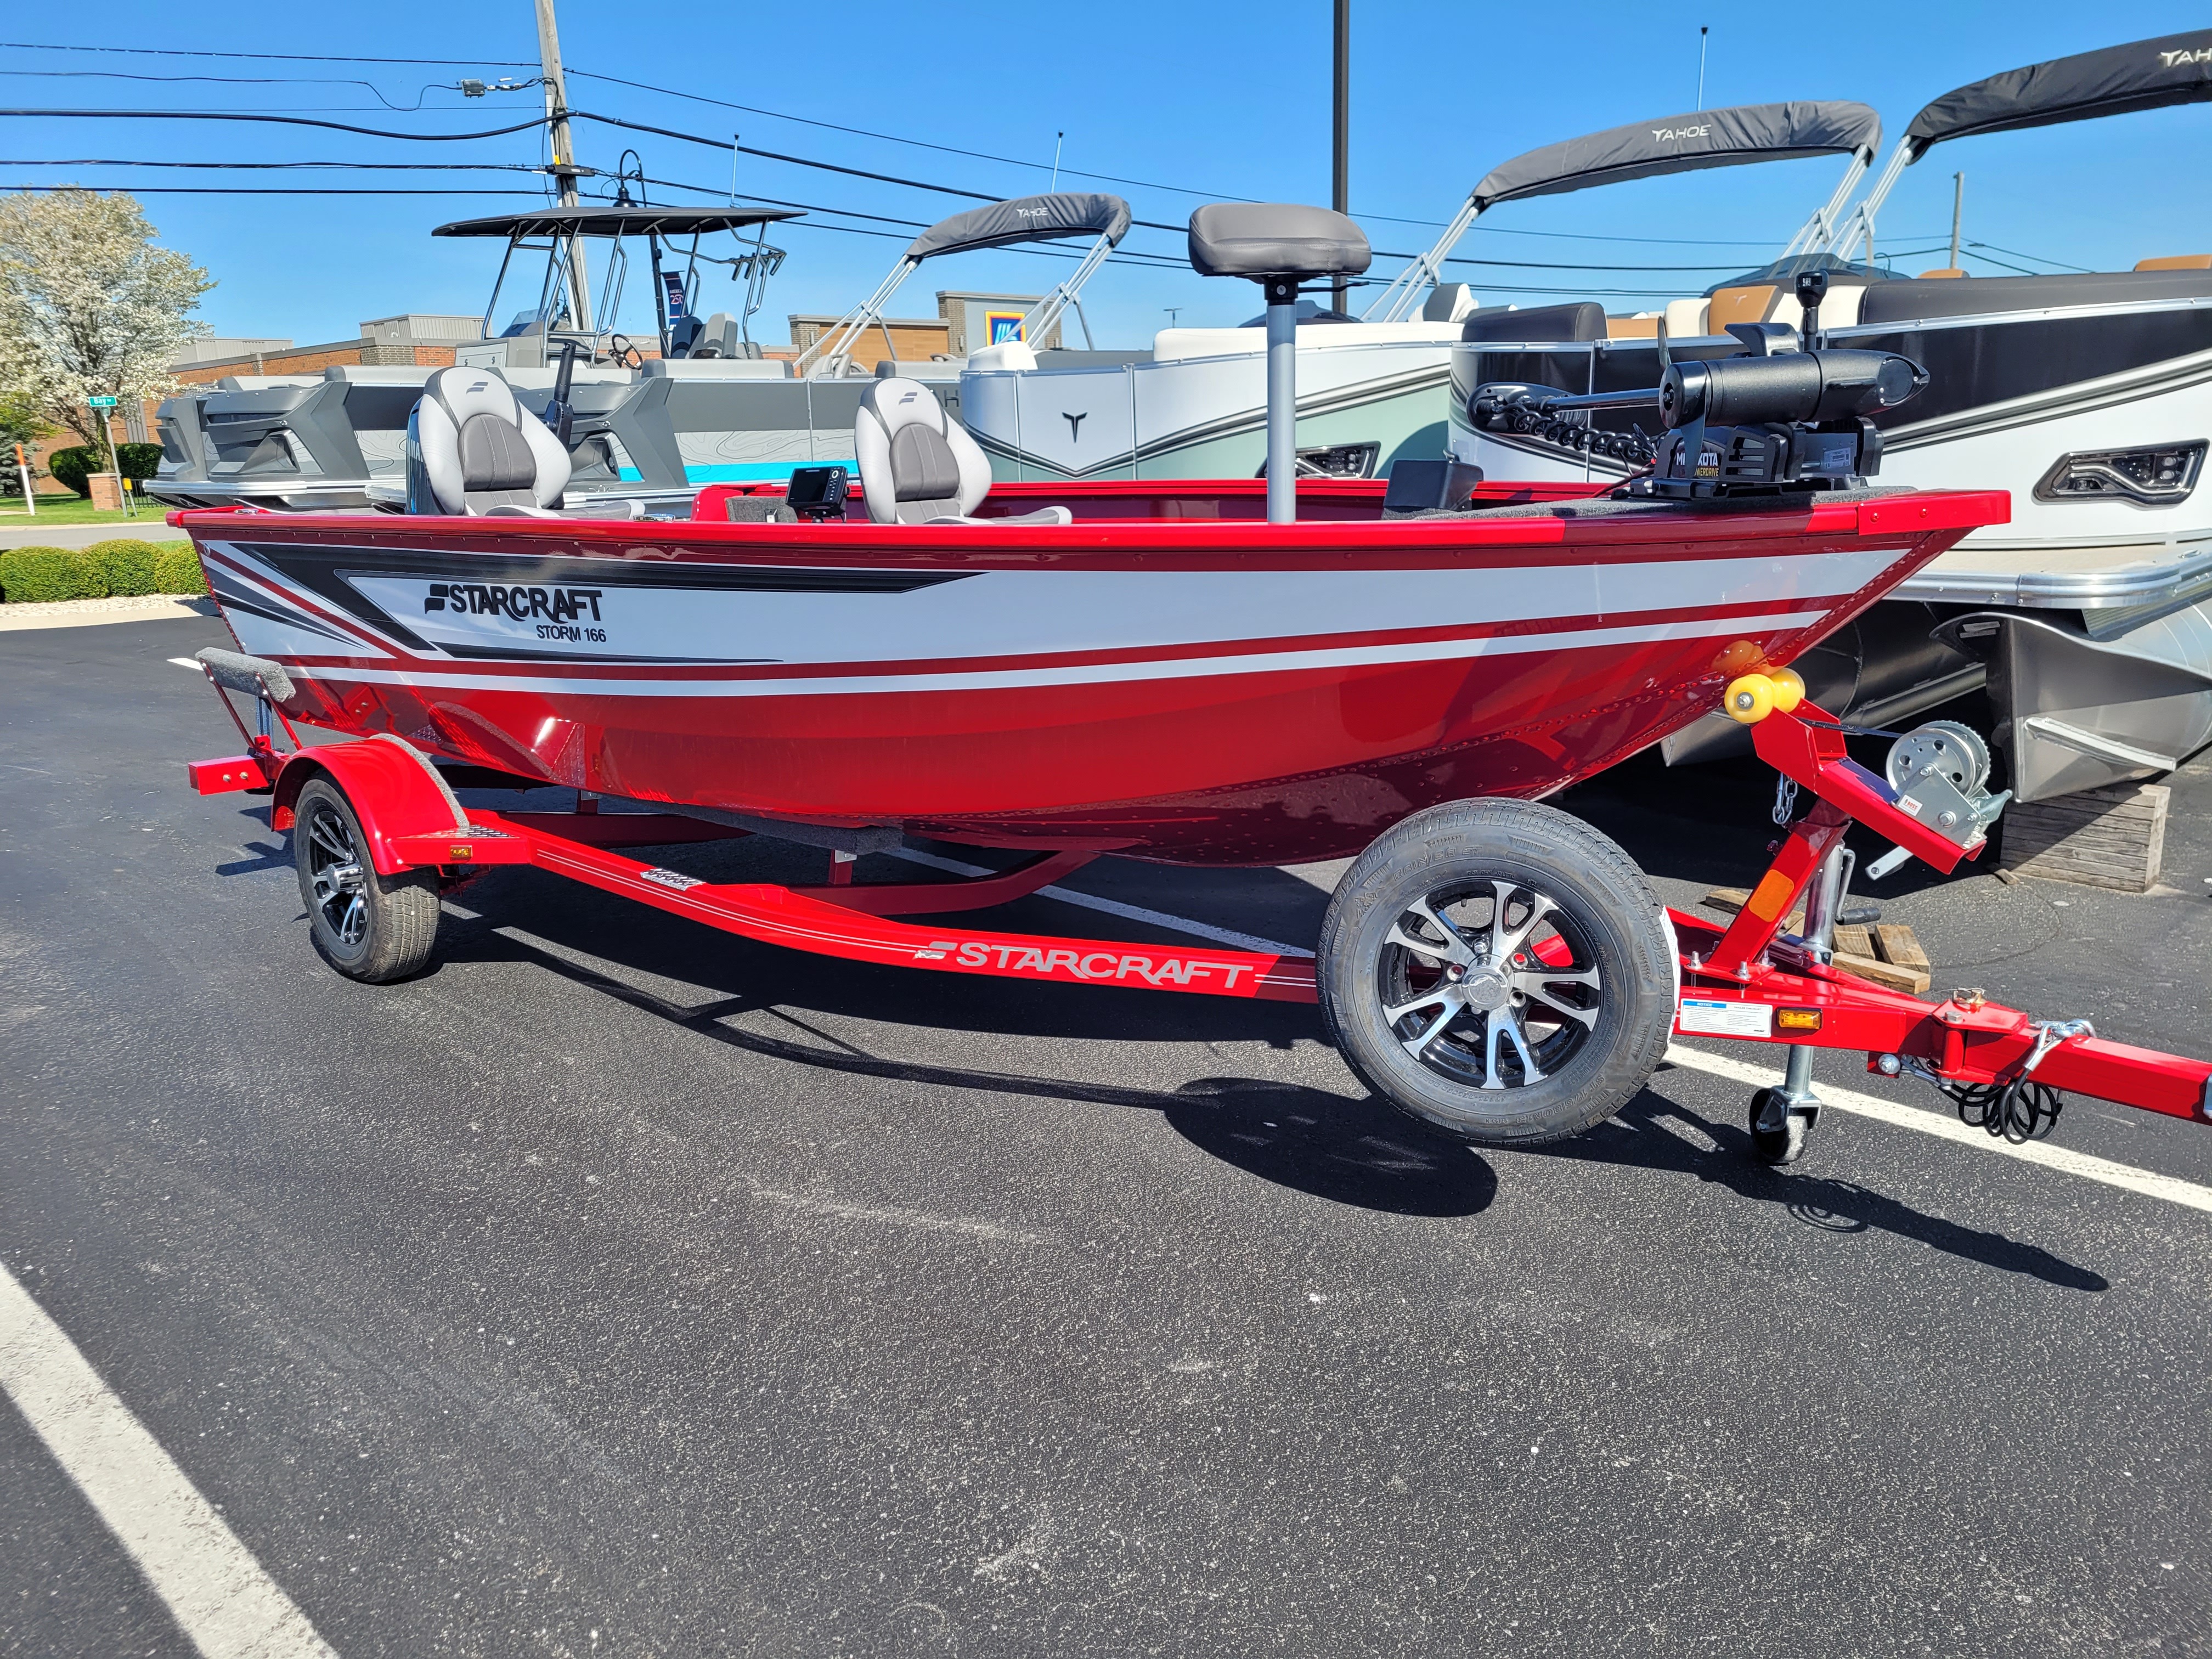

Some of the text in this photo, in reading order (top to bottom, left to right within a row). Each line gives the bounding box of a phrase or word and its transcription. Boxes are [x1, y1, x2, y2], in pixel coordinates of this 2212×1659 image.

[1651, 123, 1712, 143] TAHOE
[1016, 207, 1048, 218] TAHOE
[1676, 452, 1685, 466] MI
[1694, 467, 1719, 477] WERDRIVE
[449, 584, 603, 624] STARCRAFT
[536, 624, 607, 643] STORM 166
[1393, 845, 1482, 882] RAINIER ST
[956, 943, 1254, 989] STARCRAFT
